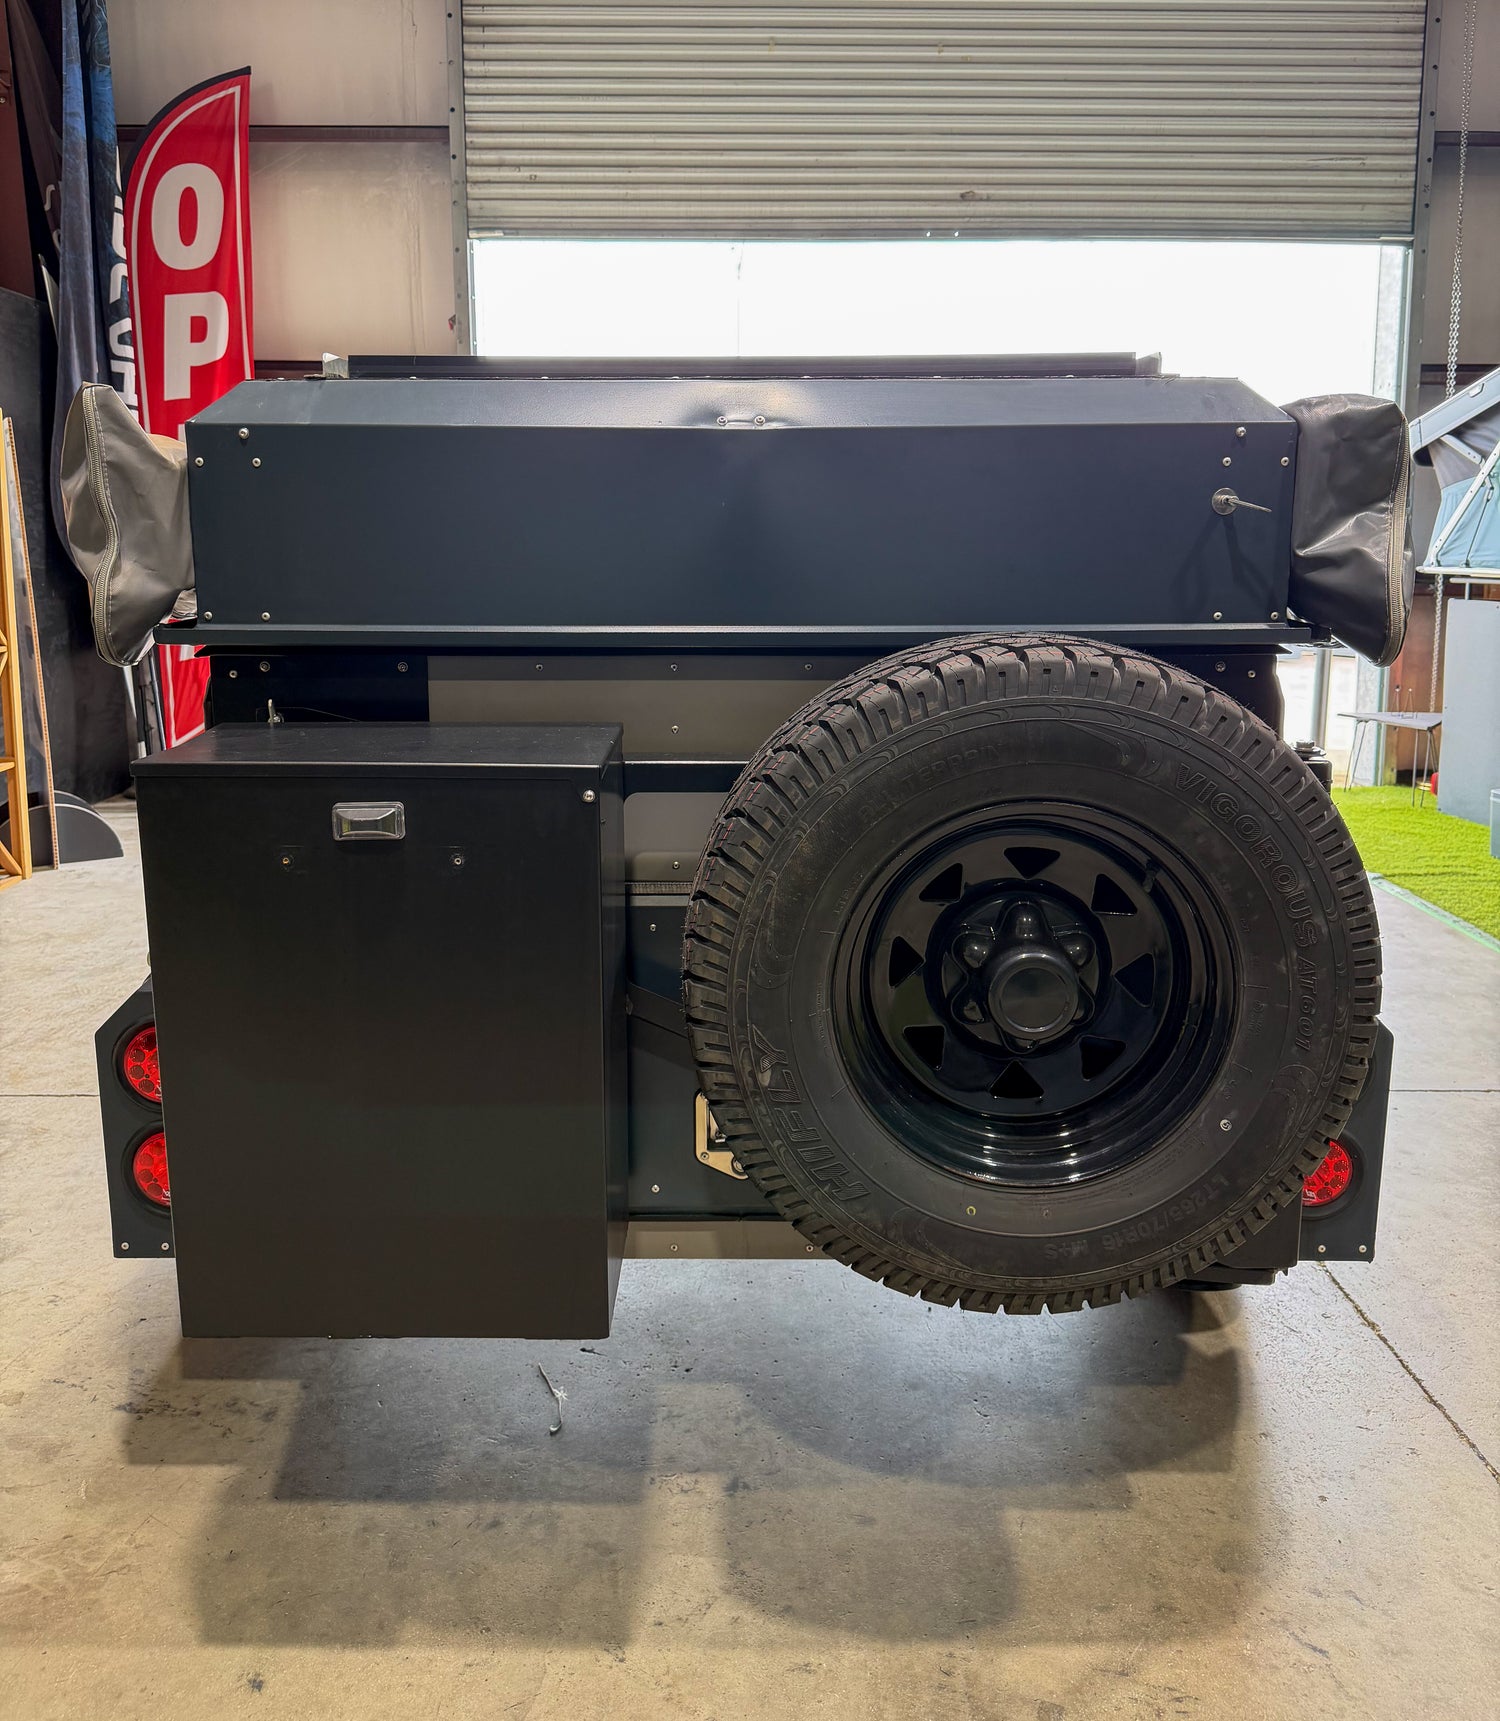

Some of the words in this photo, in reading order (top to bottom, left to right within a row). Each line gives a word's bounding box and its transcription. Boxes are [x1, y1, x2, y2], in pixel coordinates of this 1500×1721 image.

[1175, 761, 1320, 948] VIGOROUS
[1294, 955, 1320, 1053] AT601
[751, 1023, 872, 1202] HIFLY
[1041, 1238, 1090, 1261] M+S
[1100, 1172, 1231, 1252] LT265/70R16
